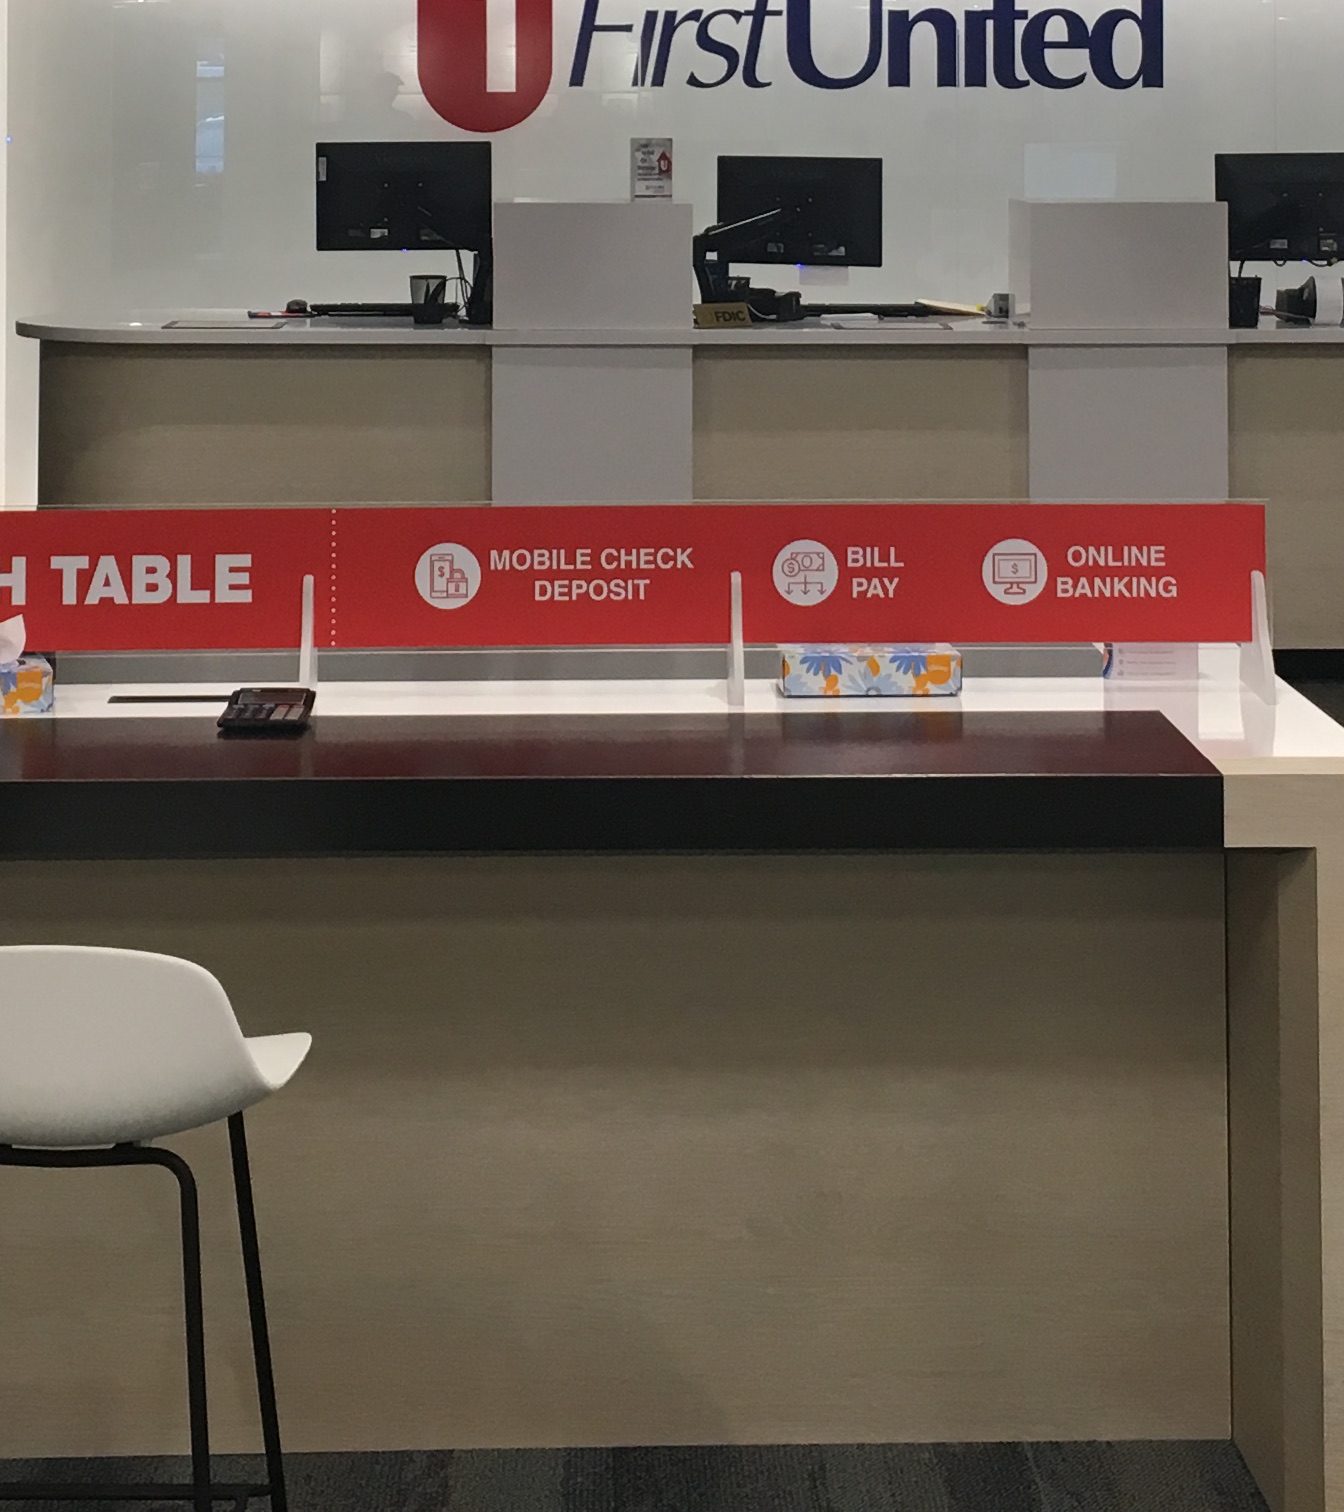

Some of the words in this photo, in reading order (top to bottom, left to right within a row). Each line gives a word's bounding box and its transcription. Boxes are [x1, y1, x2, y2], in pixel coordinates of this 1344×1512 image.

[714, 310, 746, 322] FDIC
[490, 548, 592, 571] MOBILE
[600, 547, 694, 570] CHECK
[847, 546, 905, 568] BILL
[1067, 545, 1166, 567] ONLINE
[50, 553, 253, 605] TABLE
[534, 578, 650, 601] DEPOSIT
[852, 577, 900, 599] PAY
[1056, 576, 1178, 598] BANKING
